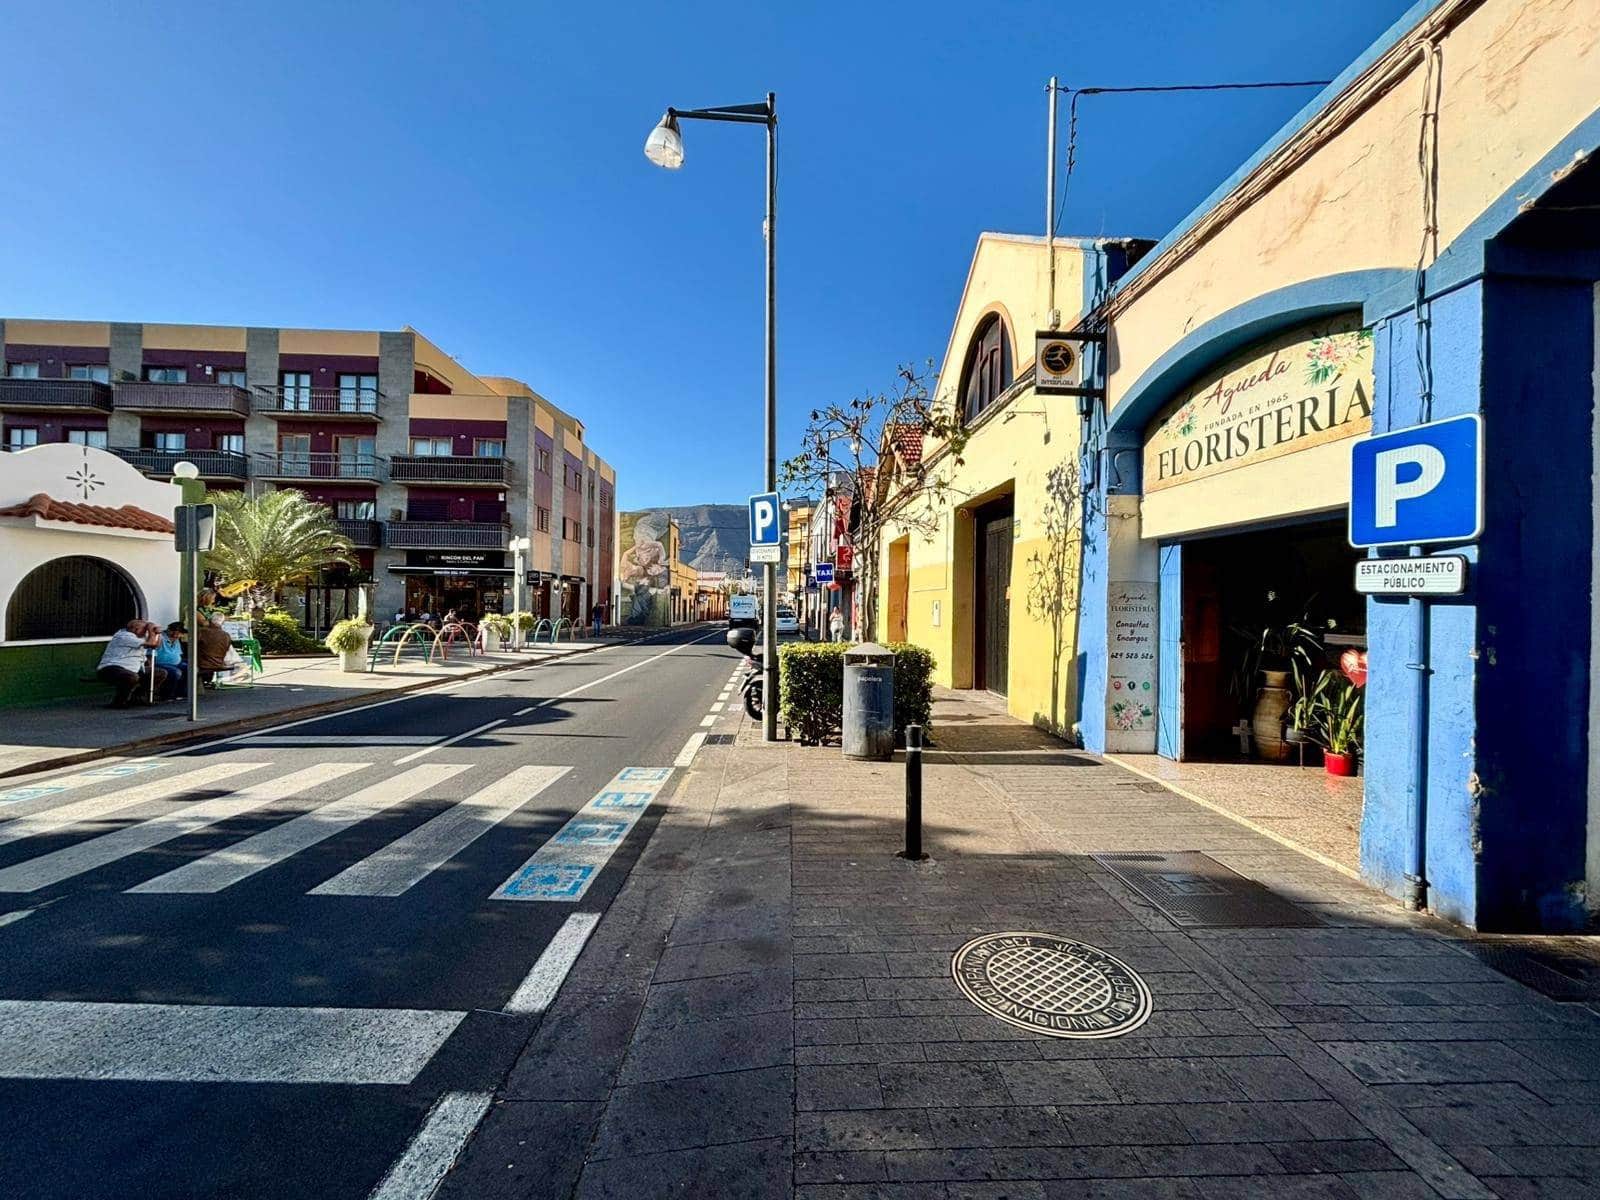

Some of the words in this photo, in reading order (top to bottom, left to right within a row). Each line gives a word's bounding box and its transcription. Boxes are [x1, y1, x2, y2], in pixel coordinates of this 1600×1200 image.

[1204, 412, 1243, 432] FUNDADA
[1249, 403, 1261, 414] EN
[1267, 393, 1289, 408] 1965
[1158, 373, 1373, 480] FLORISTERÍA
[1376, 444, 1446, 528] P
[755, 501, 773, 540] P
[1361, 562, 1455, 575] ESTACIONAMIENTO
[1384, 576, 1426, 588] PÚBLICO
[1115, 620, 1149, 628] Consultas
[1116, 634, 1148, 643] Encargos
[1007, 1003, 1110, 1029] NACIONAL
